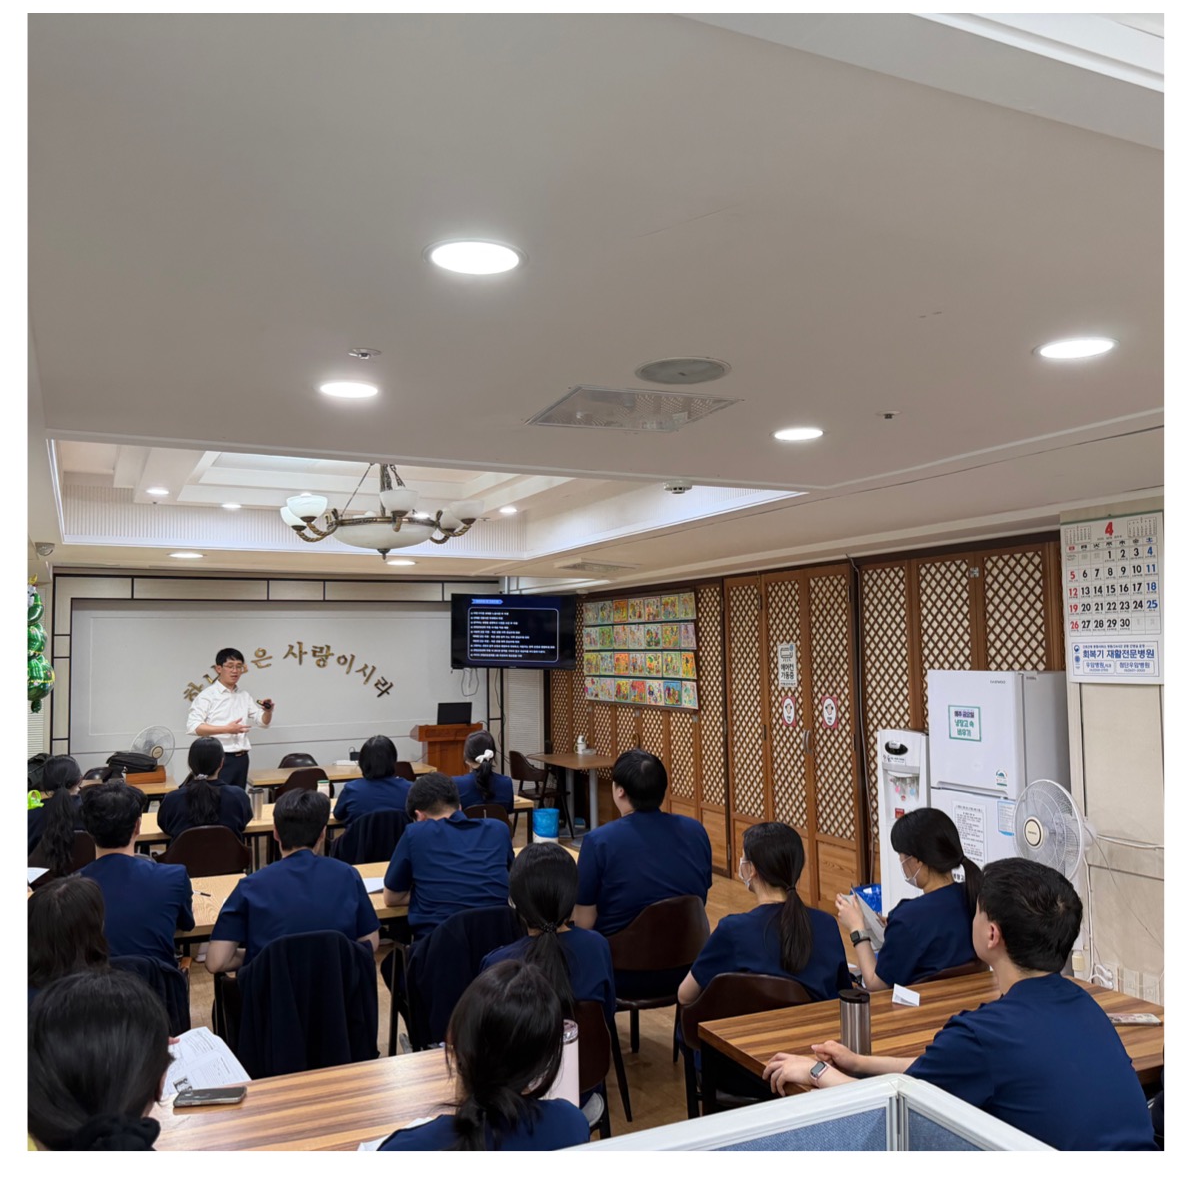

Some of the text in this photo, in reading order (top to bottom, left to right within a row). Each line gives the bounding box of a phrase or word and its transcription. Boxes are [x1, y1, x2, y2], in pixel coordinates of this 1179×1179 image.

[1104, 521, 1114, 536] 4
[1132, 564, 1142, 574] 10
[1146, 563, 1156, 573] 11
[1068, 581, 1157, 597] 12 13 14 15 16 17 18
[1069, 599, 1158, 613] 19 20 21 22 23 24 25
[1070, 618, 1130, 630] 26 27 28 29 30
[1083, 648, 1155, 659] 회복기 재활전문병원
[282, 641, 394, 698] 사랑이시라
[780, 671, 795, 680] 가동중
[954, 718, 969, 728] 냉장고
[956, 728, 972, 737] 비우기
